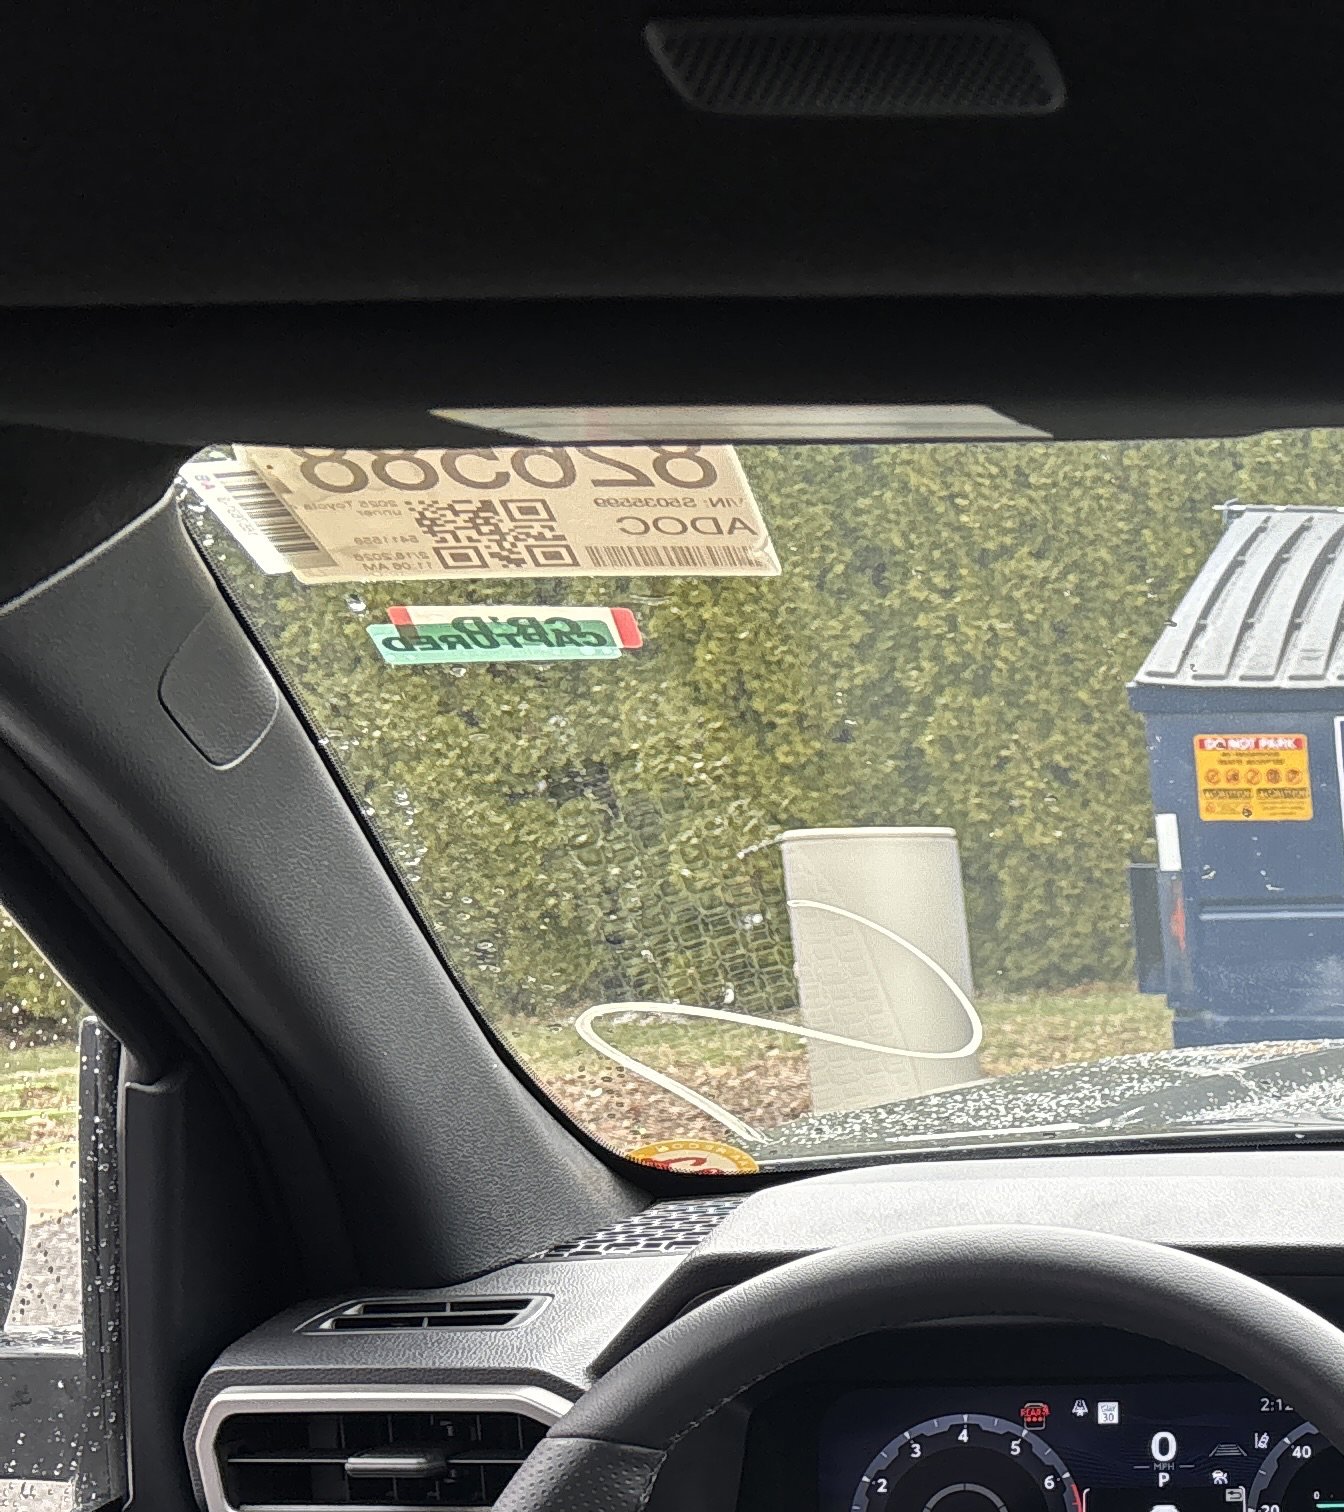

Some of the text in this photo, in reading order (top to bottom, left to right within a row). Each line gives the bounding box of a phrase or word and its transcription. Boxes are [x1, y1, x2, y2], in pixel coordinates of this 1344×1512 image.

[957, 1429, 969, 1443] 4
[910, 1443, 921, 1458] 3
[1010, 1440, 1021, 1456] 5
[1150, 1431, 1177, 1462] 0
[1292, 1445, 1312, 1459] 40
[876, 1478, 888, 1493] 2
[1044, 1475, 1055, 1490] 6
[1158, 1472, 1170, 1488] P
